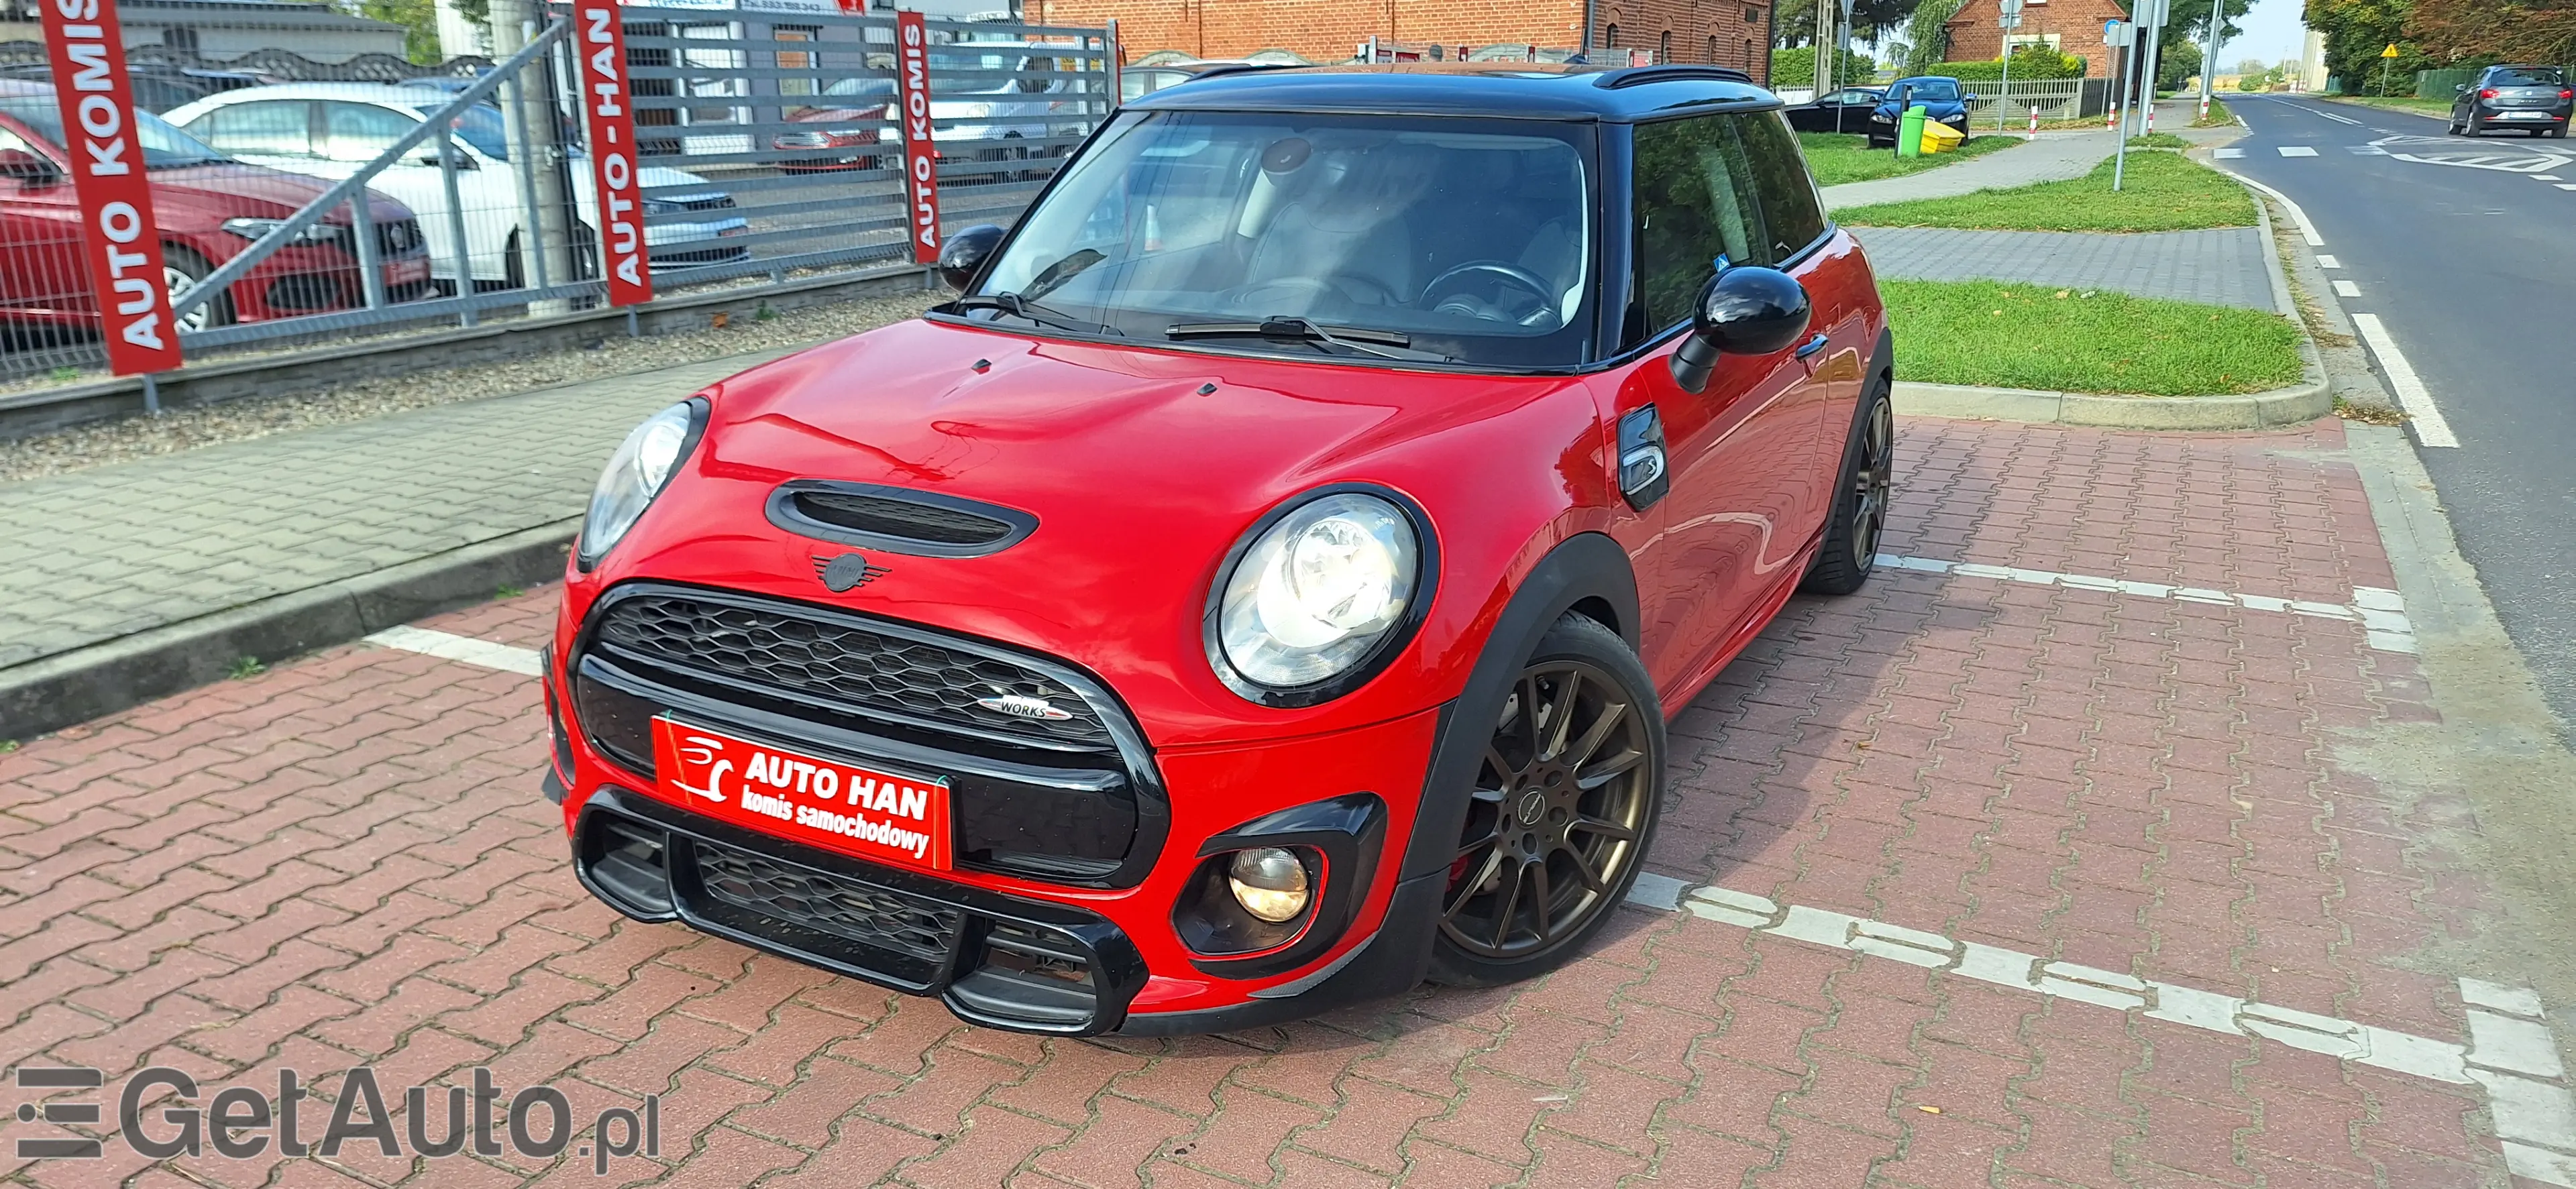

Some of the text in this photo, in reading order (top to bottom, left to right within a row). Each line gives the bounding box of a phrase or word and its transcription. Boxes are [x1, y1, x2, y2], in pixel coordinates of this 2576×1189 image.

[904, 24, 936, 248] AUTO KOMIS
[56, 0, 164, 351] AUTO KOMIS
[1001, 701, 1046, 718] WORKS
[741, 785, 930, 859] komis samochodowy
[745, 752, 927, 820] AUTO HAN
